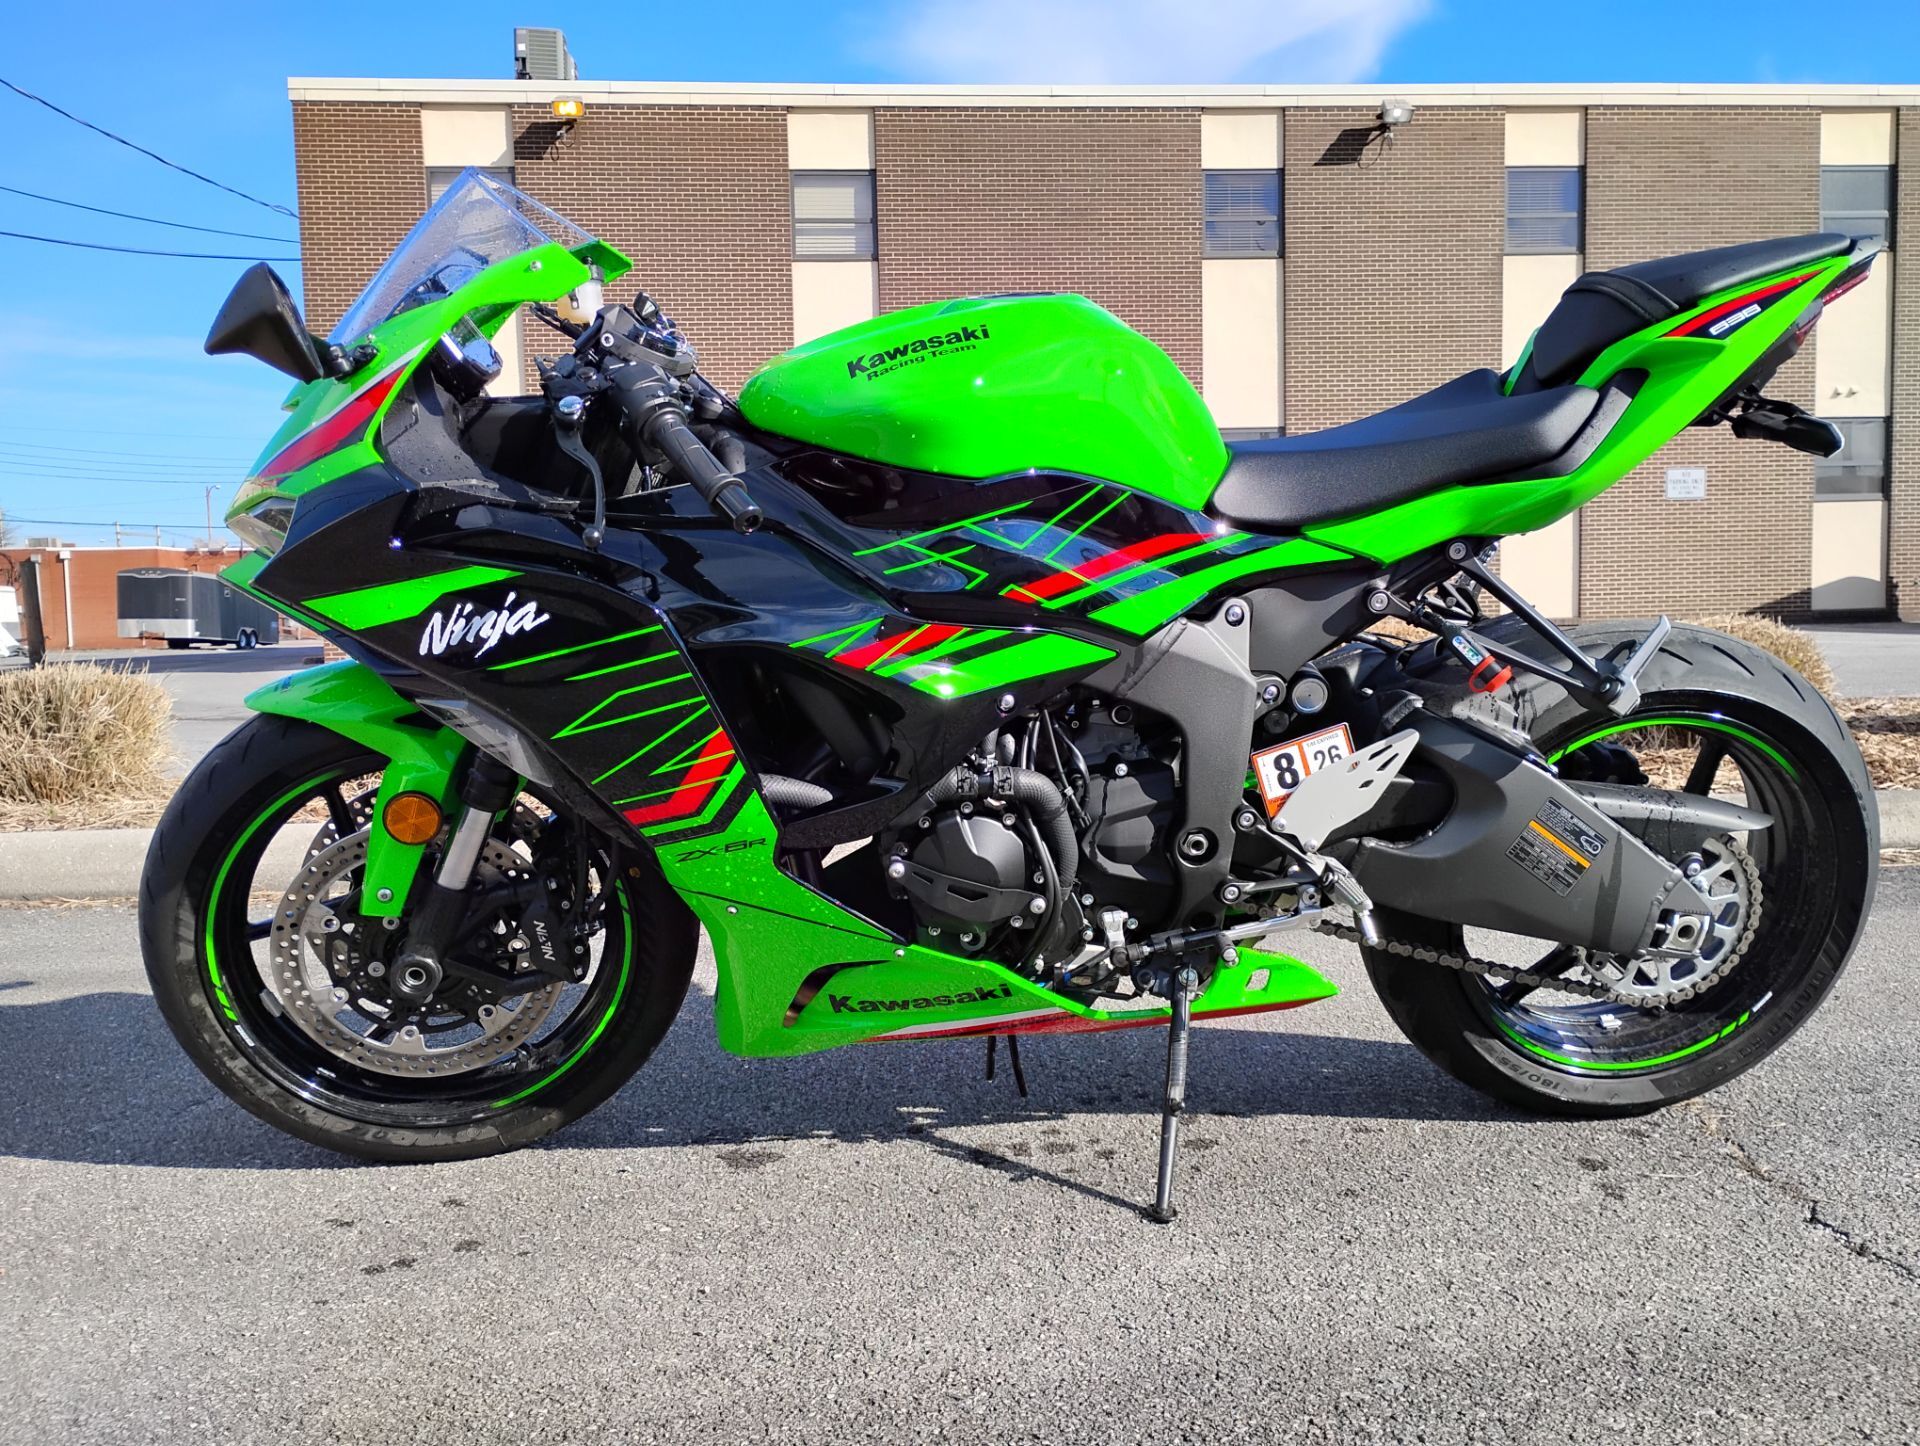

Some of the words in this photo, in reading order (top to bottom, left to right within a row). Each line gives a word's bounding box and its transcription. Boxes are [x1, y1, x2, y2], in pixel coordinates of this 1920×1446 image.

[847, 324, 990, 379] Kawasaki
[867, 355, 925, 381] Racing
[928, 343, 977, 358] Team
[419, 591, 550, 658] Ninja
[1273, 752, 1300, 790] 8
[674, 837, 767, 863] ZX-6R
[828, 984, 1013, 1013] Kawasaki
